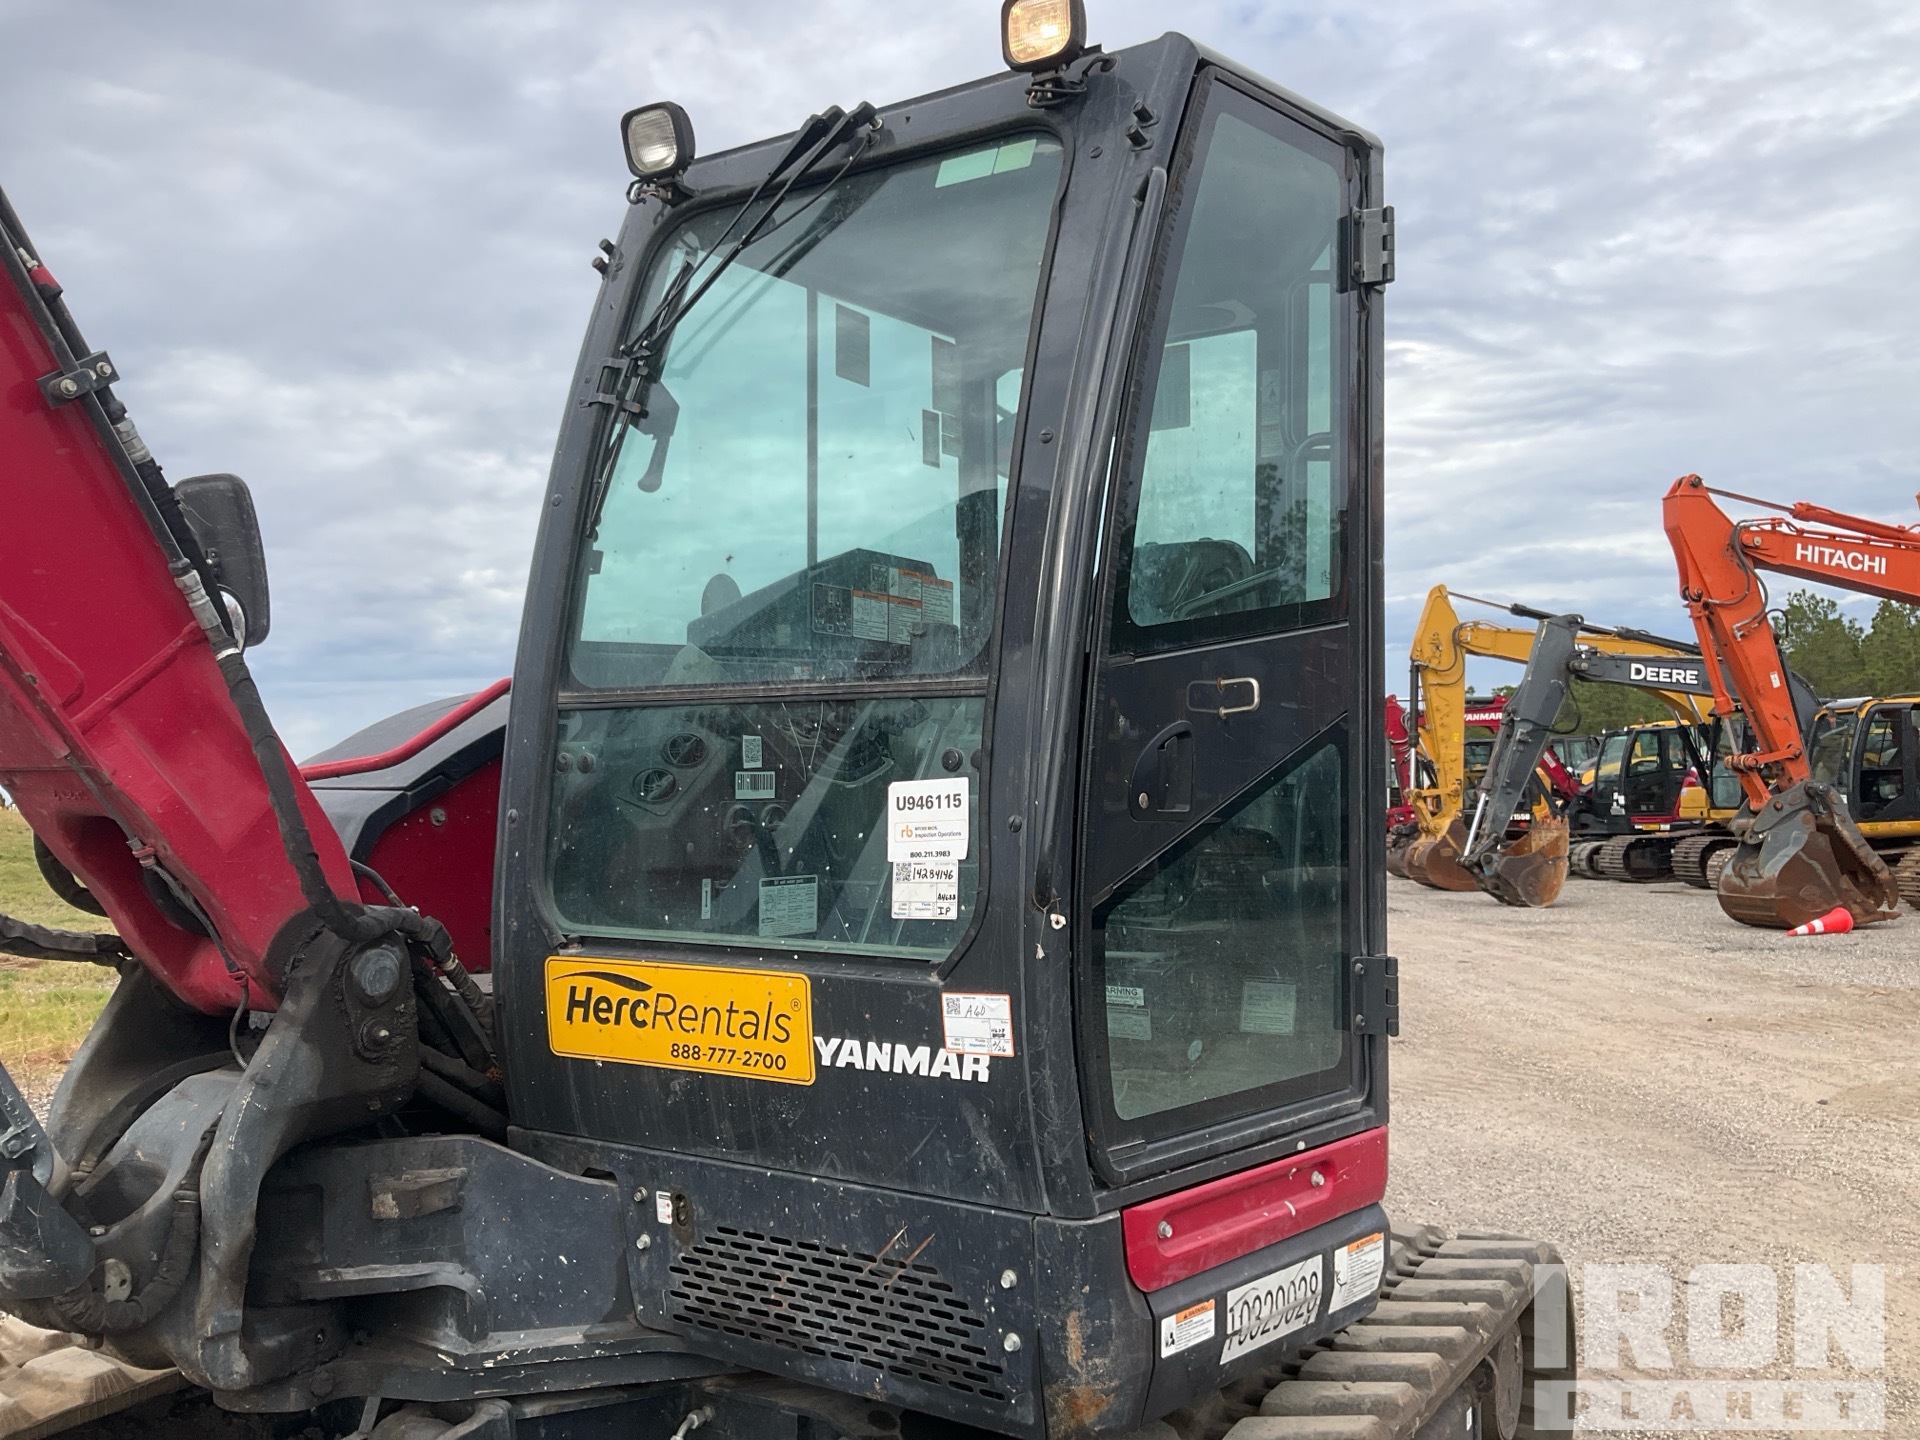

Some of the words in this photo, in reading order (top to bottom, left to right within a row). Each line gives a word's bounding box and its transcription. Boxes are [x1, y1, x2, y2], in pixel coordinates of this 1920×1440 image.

[1795, 542, 1887, 575] HITACHI
[1630, 663, 1699, 685] DEERE
[1463, 712, 1503, 721] ANMAR
[896, 793, 962, 811] U946115
[901, 824, 913, 838] rb
[910, 850, 951, 858] 800.211.3983
[670, 1043, 787, 1071] 888-777-2700
[813, 1036, 990, 1083] YANMAR
